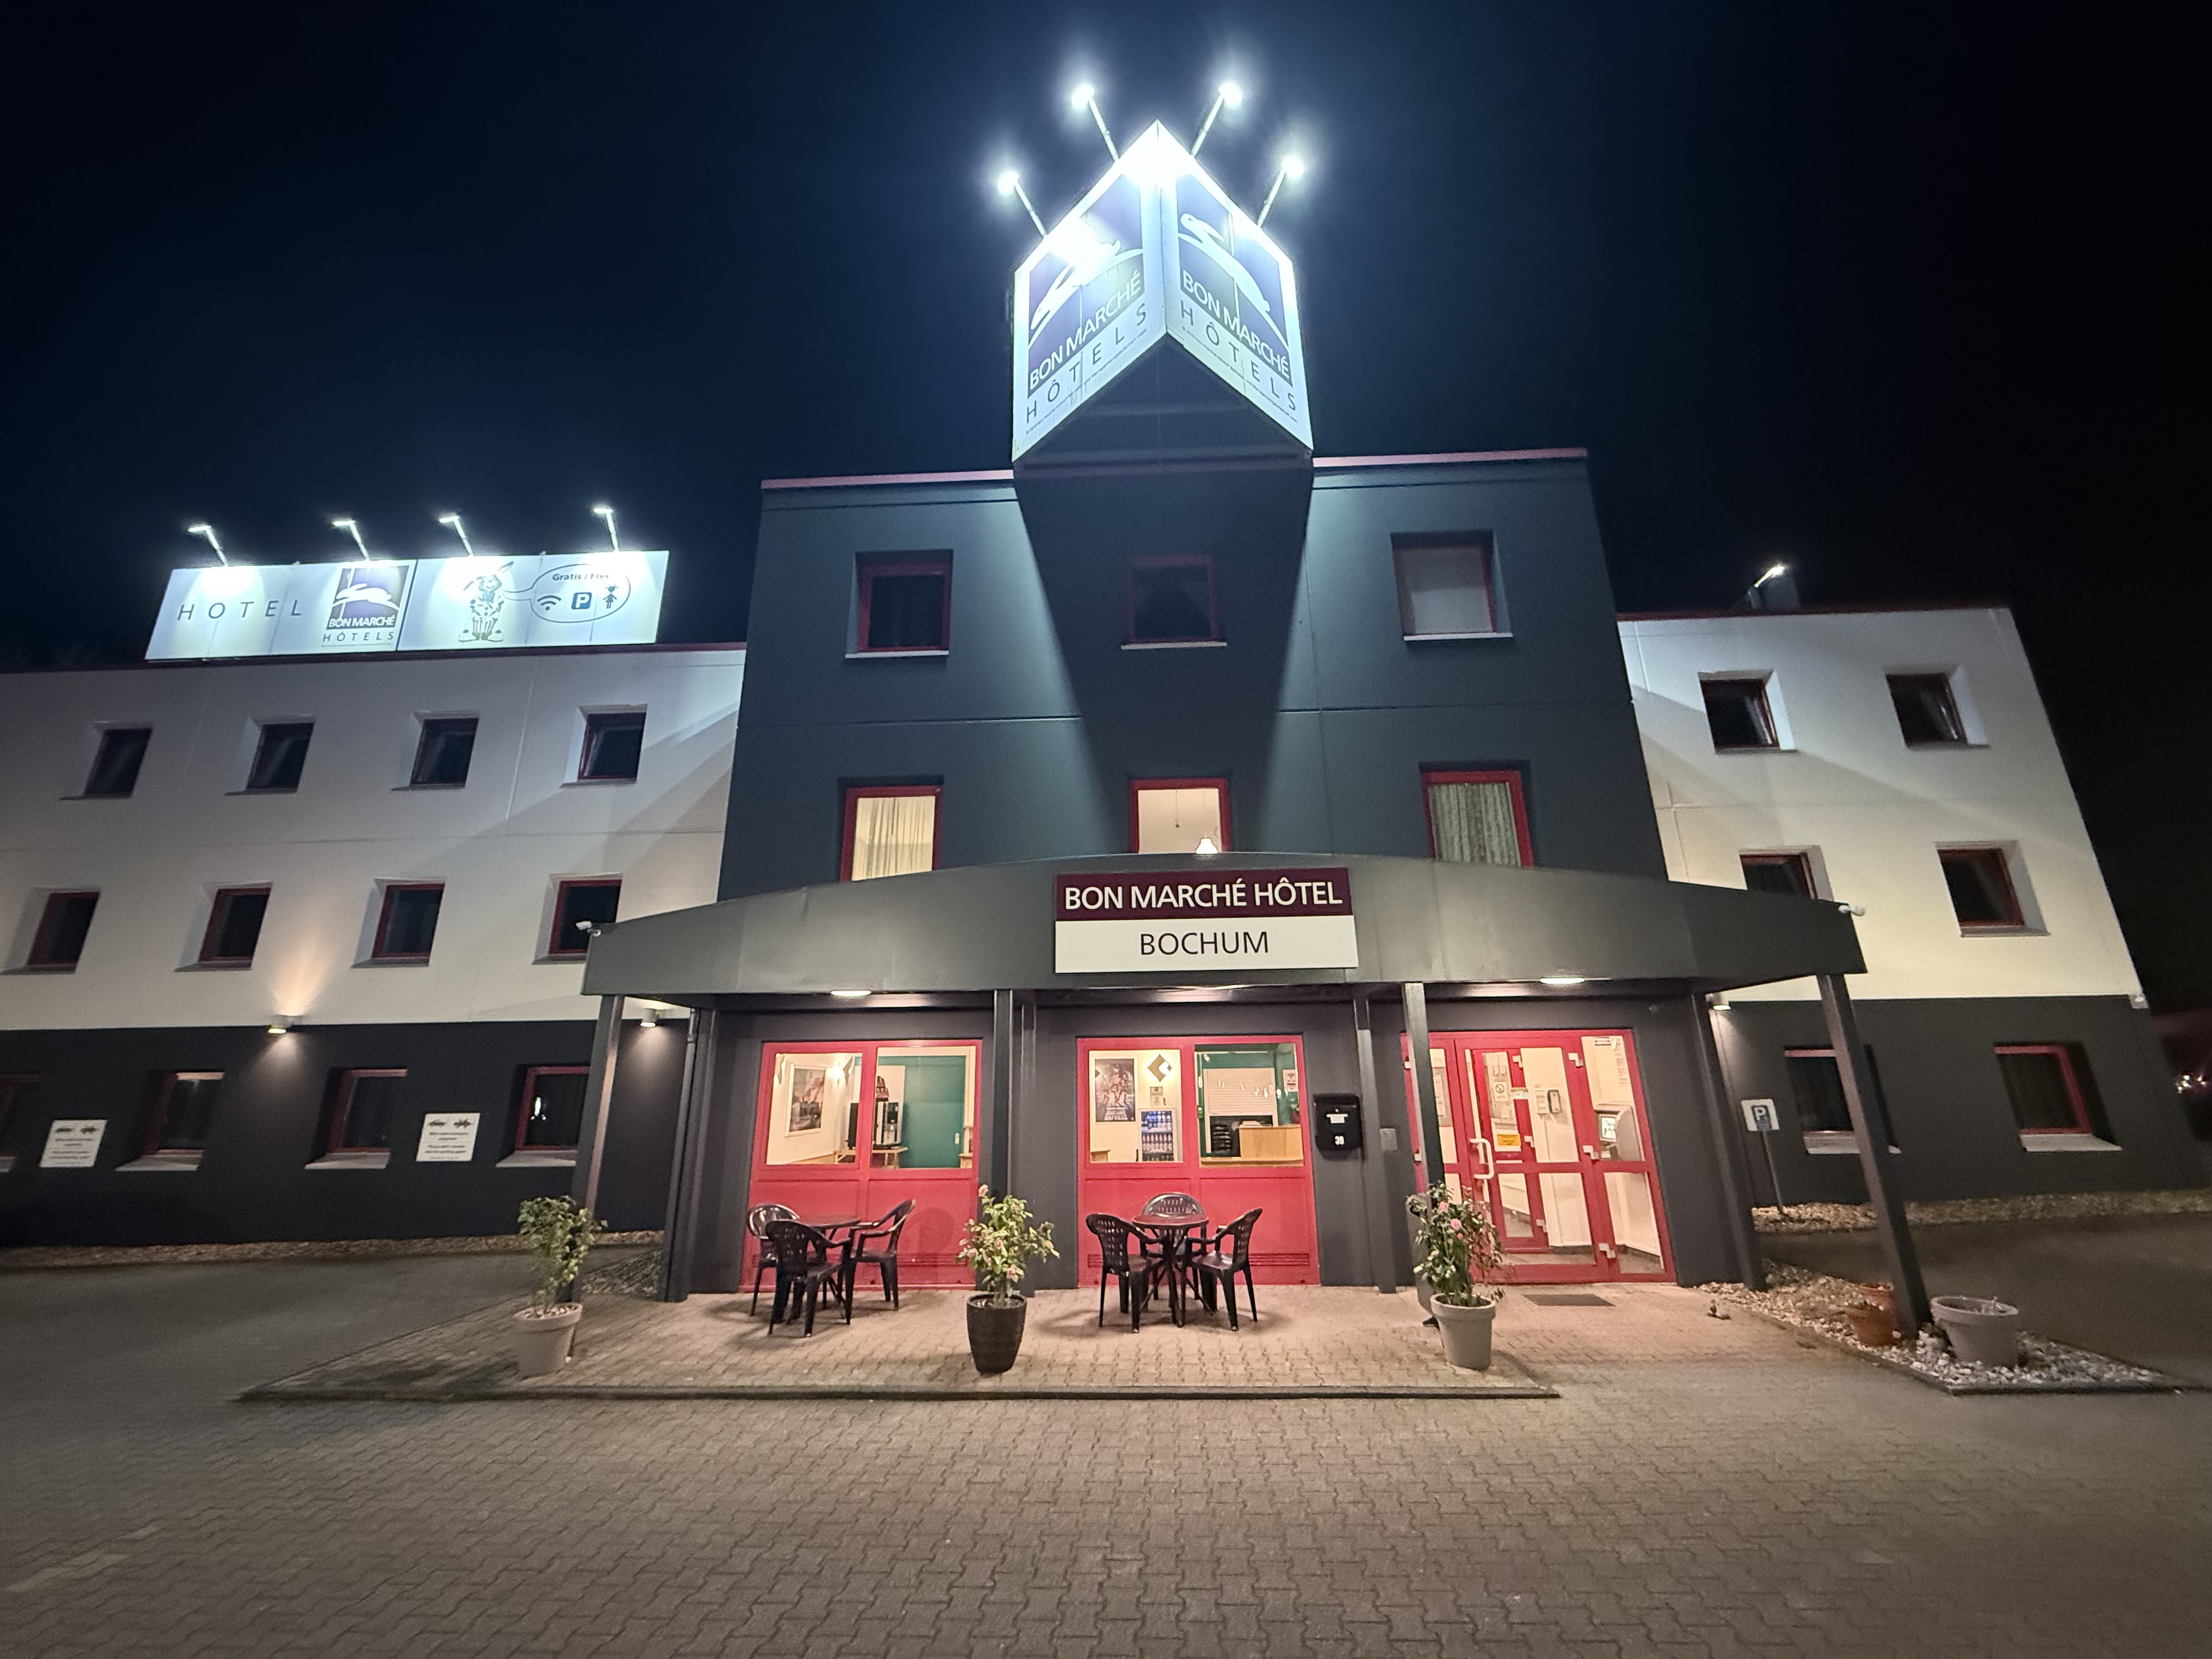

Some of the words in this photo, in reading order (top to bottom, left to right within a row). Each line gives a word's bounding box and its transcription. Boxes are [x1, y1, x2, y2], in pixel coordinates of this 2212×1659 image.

[1029, 345, 1063, 391] BON
[1066, 269, 1141, 357] MARCHÉ
[1183, 269, 1221, 319] BON
[1223, 306, 1290, 379] MARCHÉ
[1026, 302, 1147, 424] HÔTELS
[1181, 299, 1296, 411] HÔTELS
[552, 572, 582, 581] Gratis
[177, 600, 302, 621] HOTEL
[575, 593, 590, 609] P
[329, 617, 353, 628] BON
[352, 614, 396, 627] MARCHÉ
[322, 631, 394, 642] HÔTELS
[1065, 886, 1123, 910] BON
[1131, 878, 1247, 909] MARCHÉ
[1254, 877, 1343, 906] HÔTEL
[1141, 932, 1268, 955] BOCHUM
[1754, 1107, 1767, 1120] P
[1334, 1135, 1345, 1146] 39
